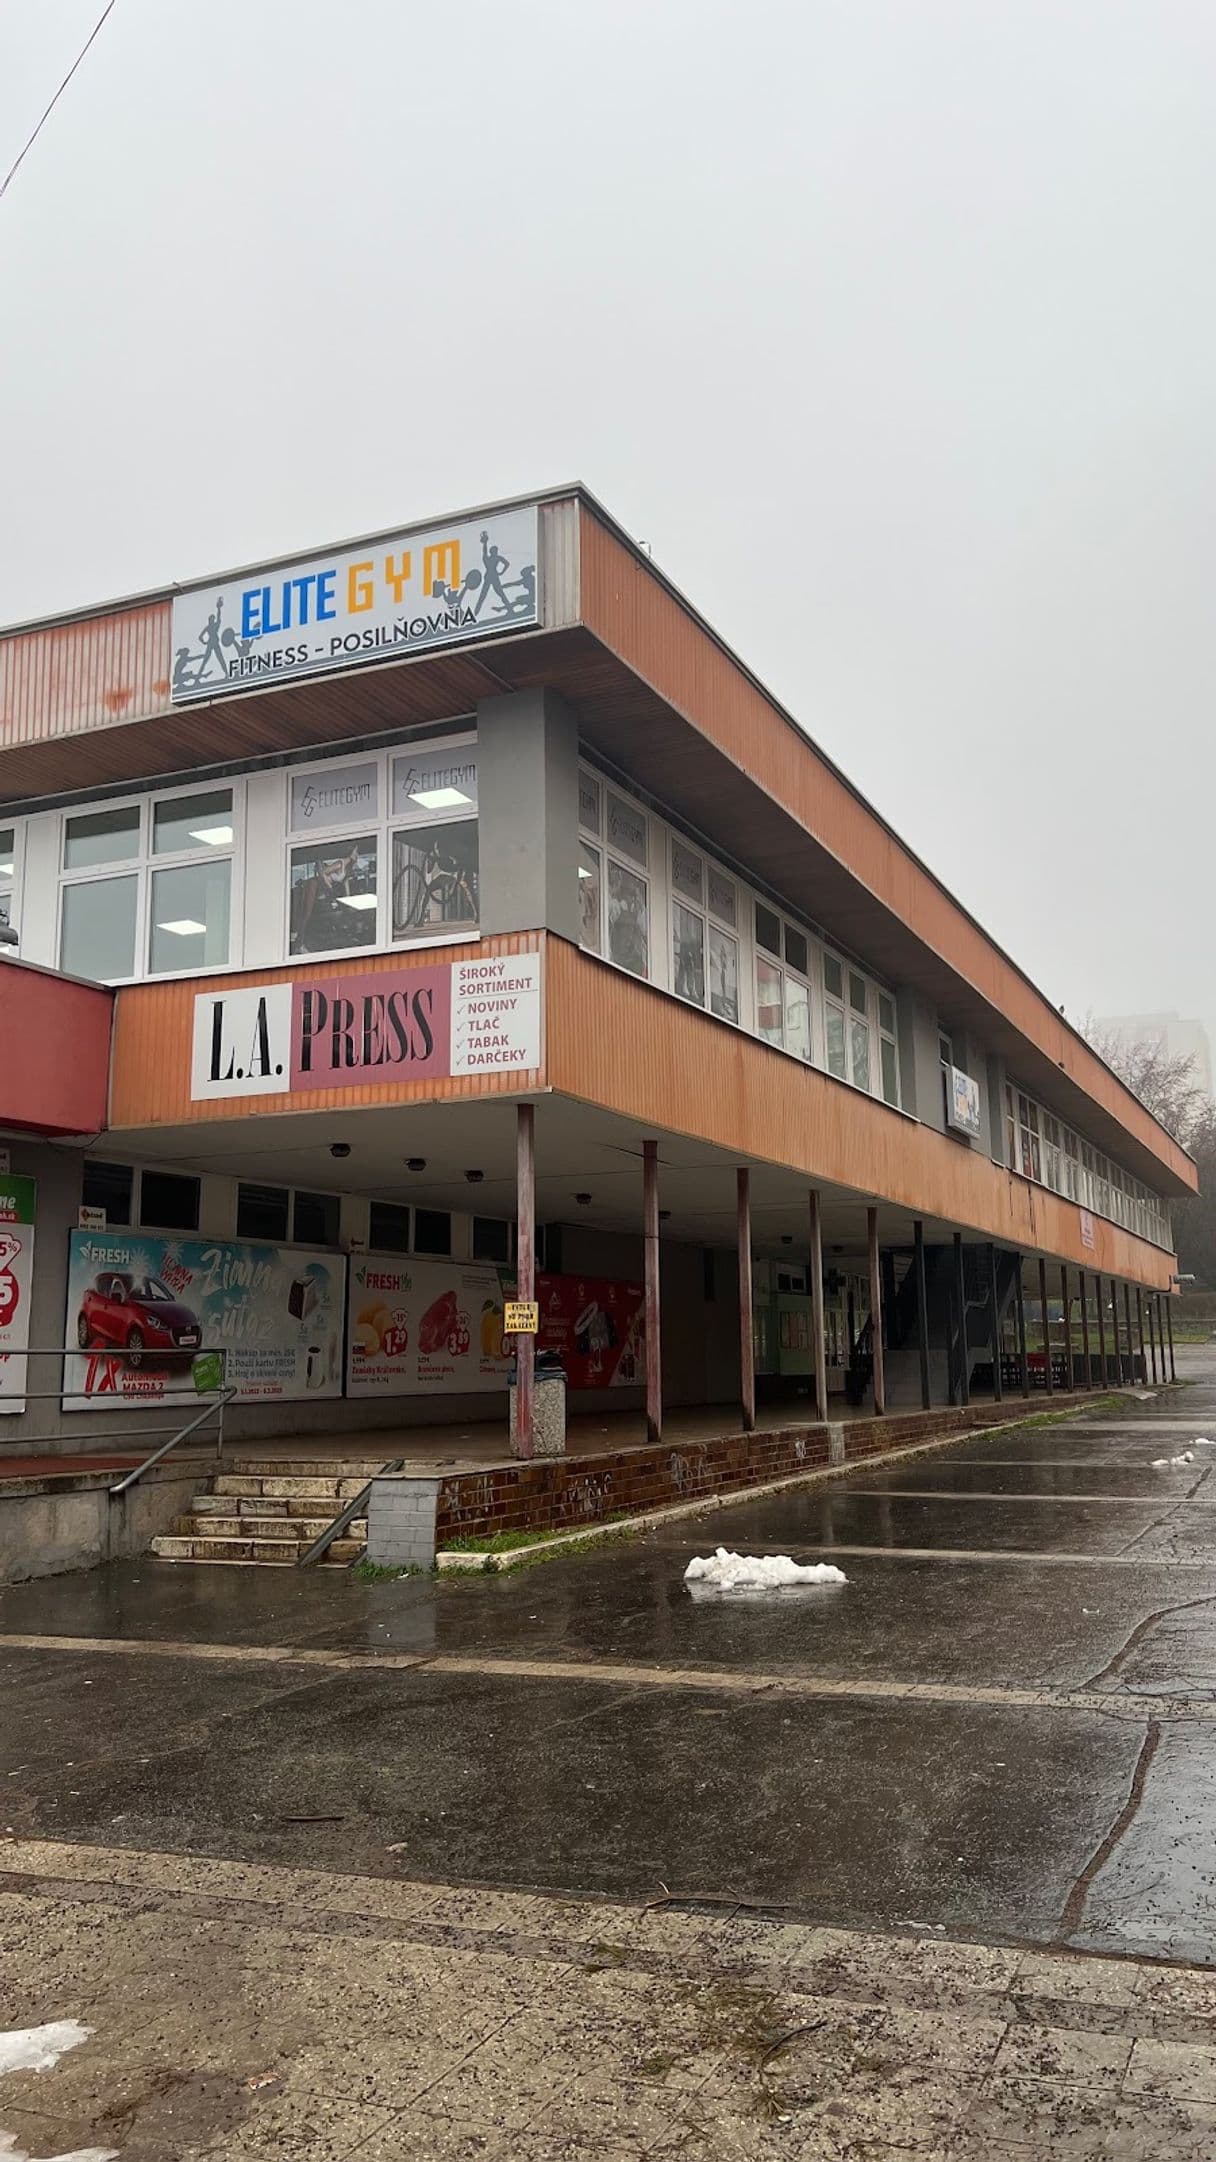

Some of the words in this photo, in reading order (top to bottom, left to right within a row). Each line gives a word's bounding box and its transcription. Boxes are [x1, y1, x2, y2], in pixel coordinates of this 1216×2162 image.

[241, 570, 337, 639] ELITE
[347, 539, 461, 615] GYM
[228, 643, 309, 679] FITNESS
[329, 605, 478, 656] POSILŇOVŇA
[421, 764, 476, 790] ELITEGYM
[318, 783, 371, 809] ELITEGYM
[459, 962, 506, 980] ŠIROKÝ
[459, 977, 533, 996] SORTIMENT
[467, 998, 518, 1015] NOVINY
[467, 1015, 501, 1032] TLAČ
[207, 996, 283, 1082] L.A.
[298, 988, 434, 1073] PRESS
[467, 1034, 510, 1049] TABAK
[467, 1048, 527, 1066] DARČEKY
[91, 1247, 130, 1264] FRESH
[366, 1272, 401, 1291] FRESH
[122, 1383, 158, 1391] MAZDA
